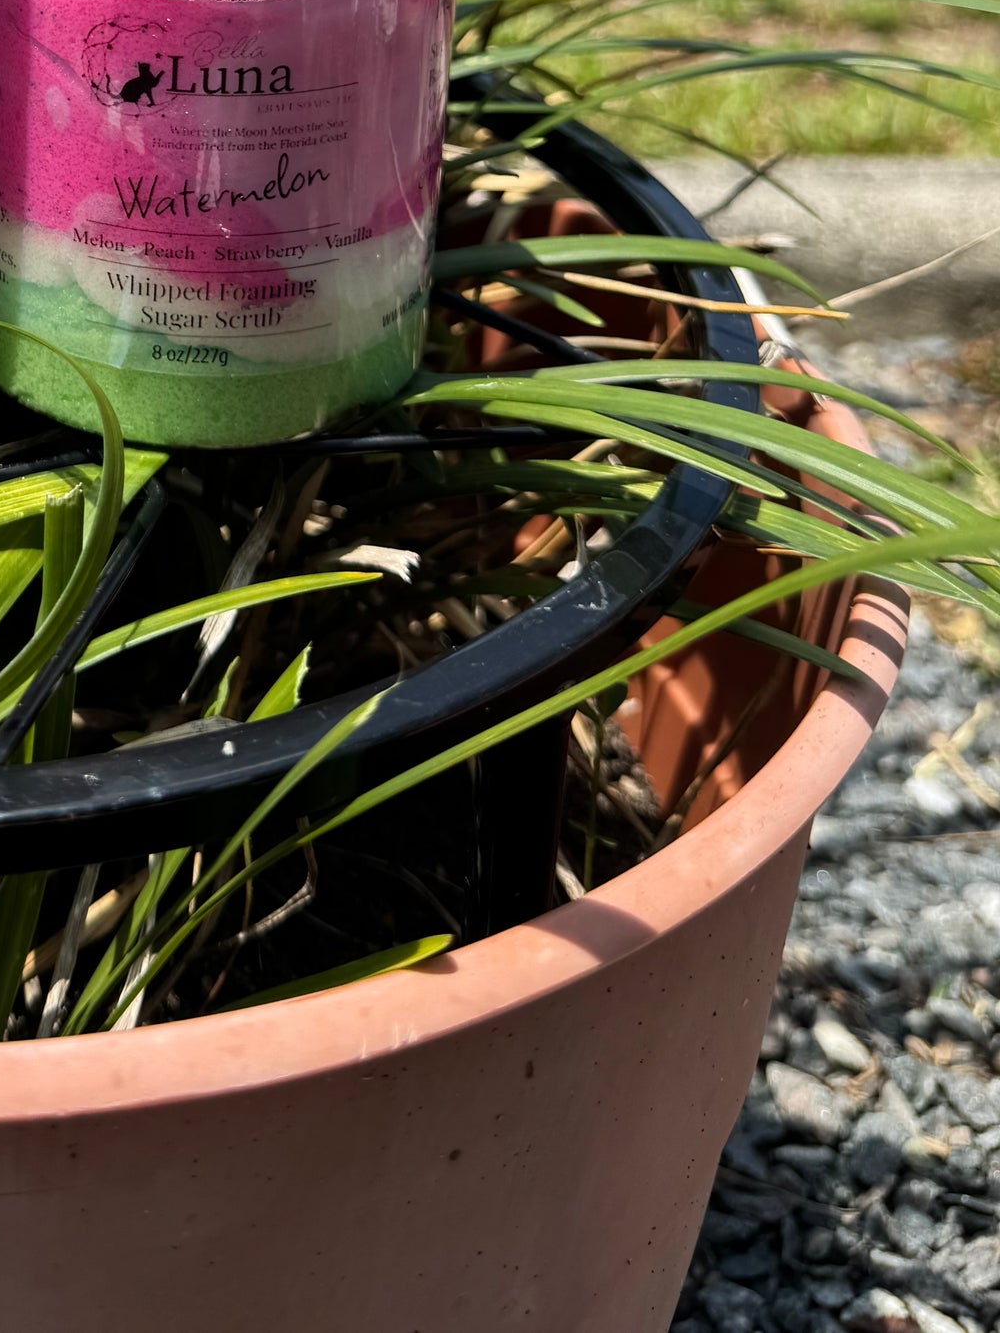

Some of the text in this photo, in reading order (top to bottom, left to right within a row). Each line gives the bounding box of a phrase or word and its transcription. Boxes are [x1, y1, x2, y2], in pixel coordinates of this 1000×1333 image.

[183, 29, 267, 68] Bella
[165, 54, 295, 95] Luna
[151, 130, 348, 152] Handcrafted from the Florida Coast
[170, 125, 208, 138] Where
[212, 124, 232, 138] the
[234, 126, 268, 138] Moon
[271, 123, 304, 137] Meets
[306, 120, 325, 133] the
[113, 153, 331, 220] Watermelon
[72, 226, 374, 263] Melon Peach Strawberry Vanilla
[106, 271, 318, 304] Whipped Foaming
[140, 305, 282, 331] Sugar Scrub
[151, 343, 230, 368] 8 oz/227g
